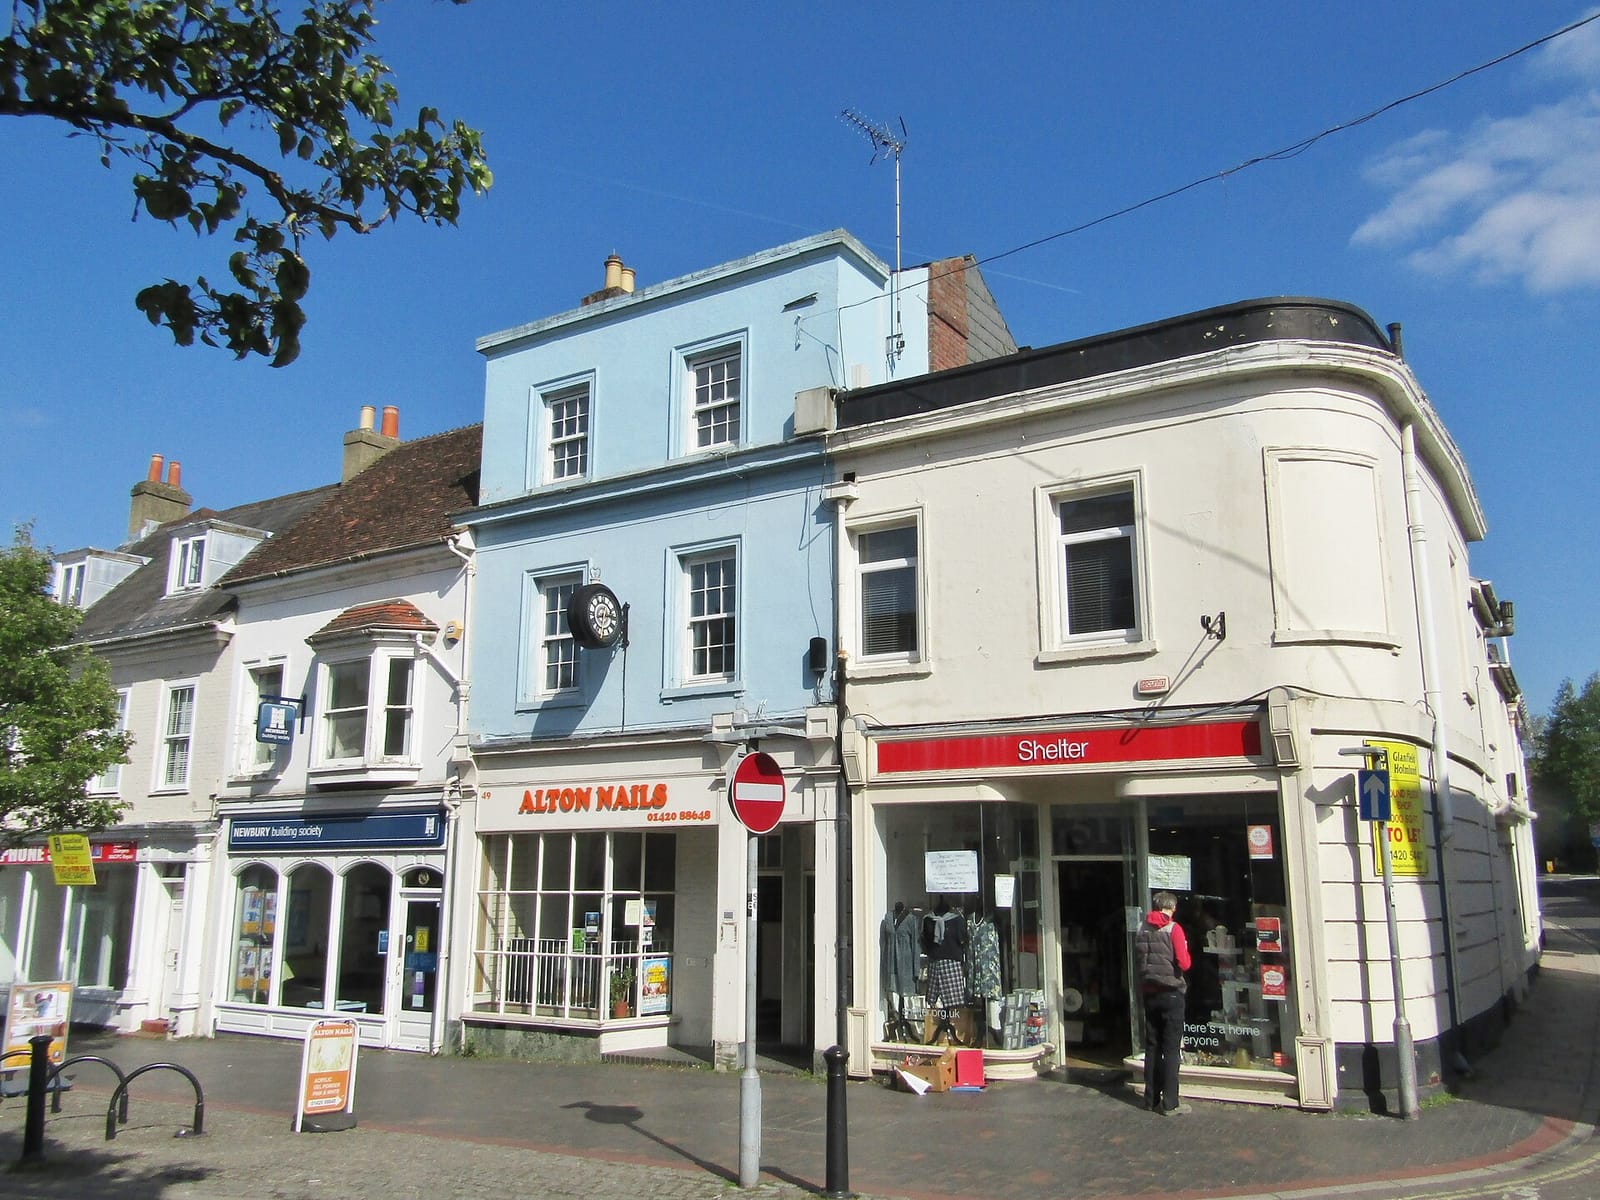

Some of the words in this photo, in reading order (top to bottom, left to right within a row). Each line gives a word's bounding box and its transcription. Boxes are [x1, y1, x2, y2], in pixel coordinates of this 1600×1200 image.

[1018, 738, 1088, 761] Shelter
[481, 791, 491, 801] 49
[518, 787, 593, 815] ALTON
[596, 783, 668, 811] NAILS
[646, 812, 678, 823] 01420
[679, 810, 712, 821] 88648
[233, 827, 271, 837] NEWBURY
[271, 826, 298, 838] building
[298, 825, 323, 837] society
[1387, 827, 1403, 843] TO
[1390, 850, 1408, 861] 1420
[1183, 1021, 1216, 1034] here's
[1228, 1024, 1260, 1036] home
[1183, 1035, 1219, 1047] eryone
